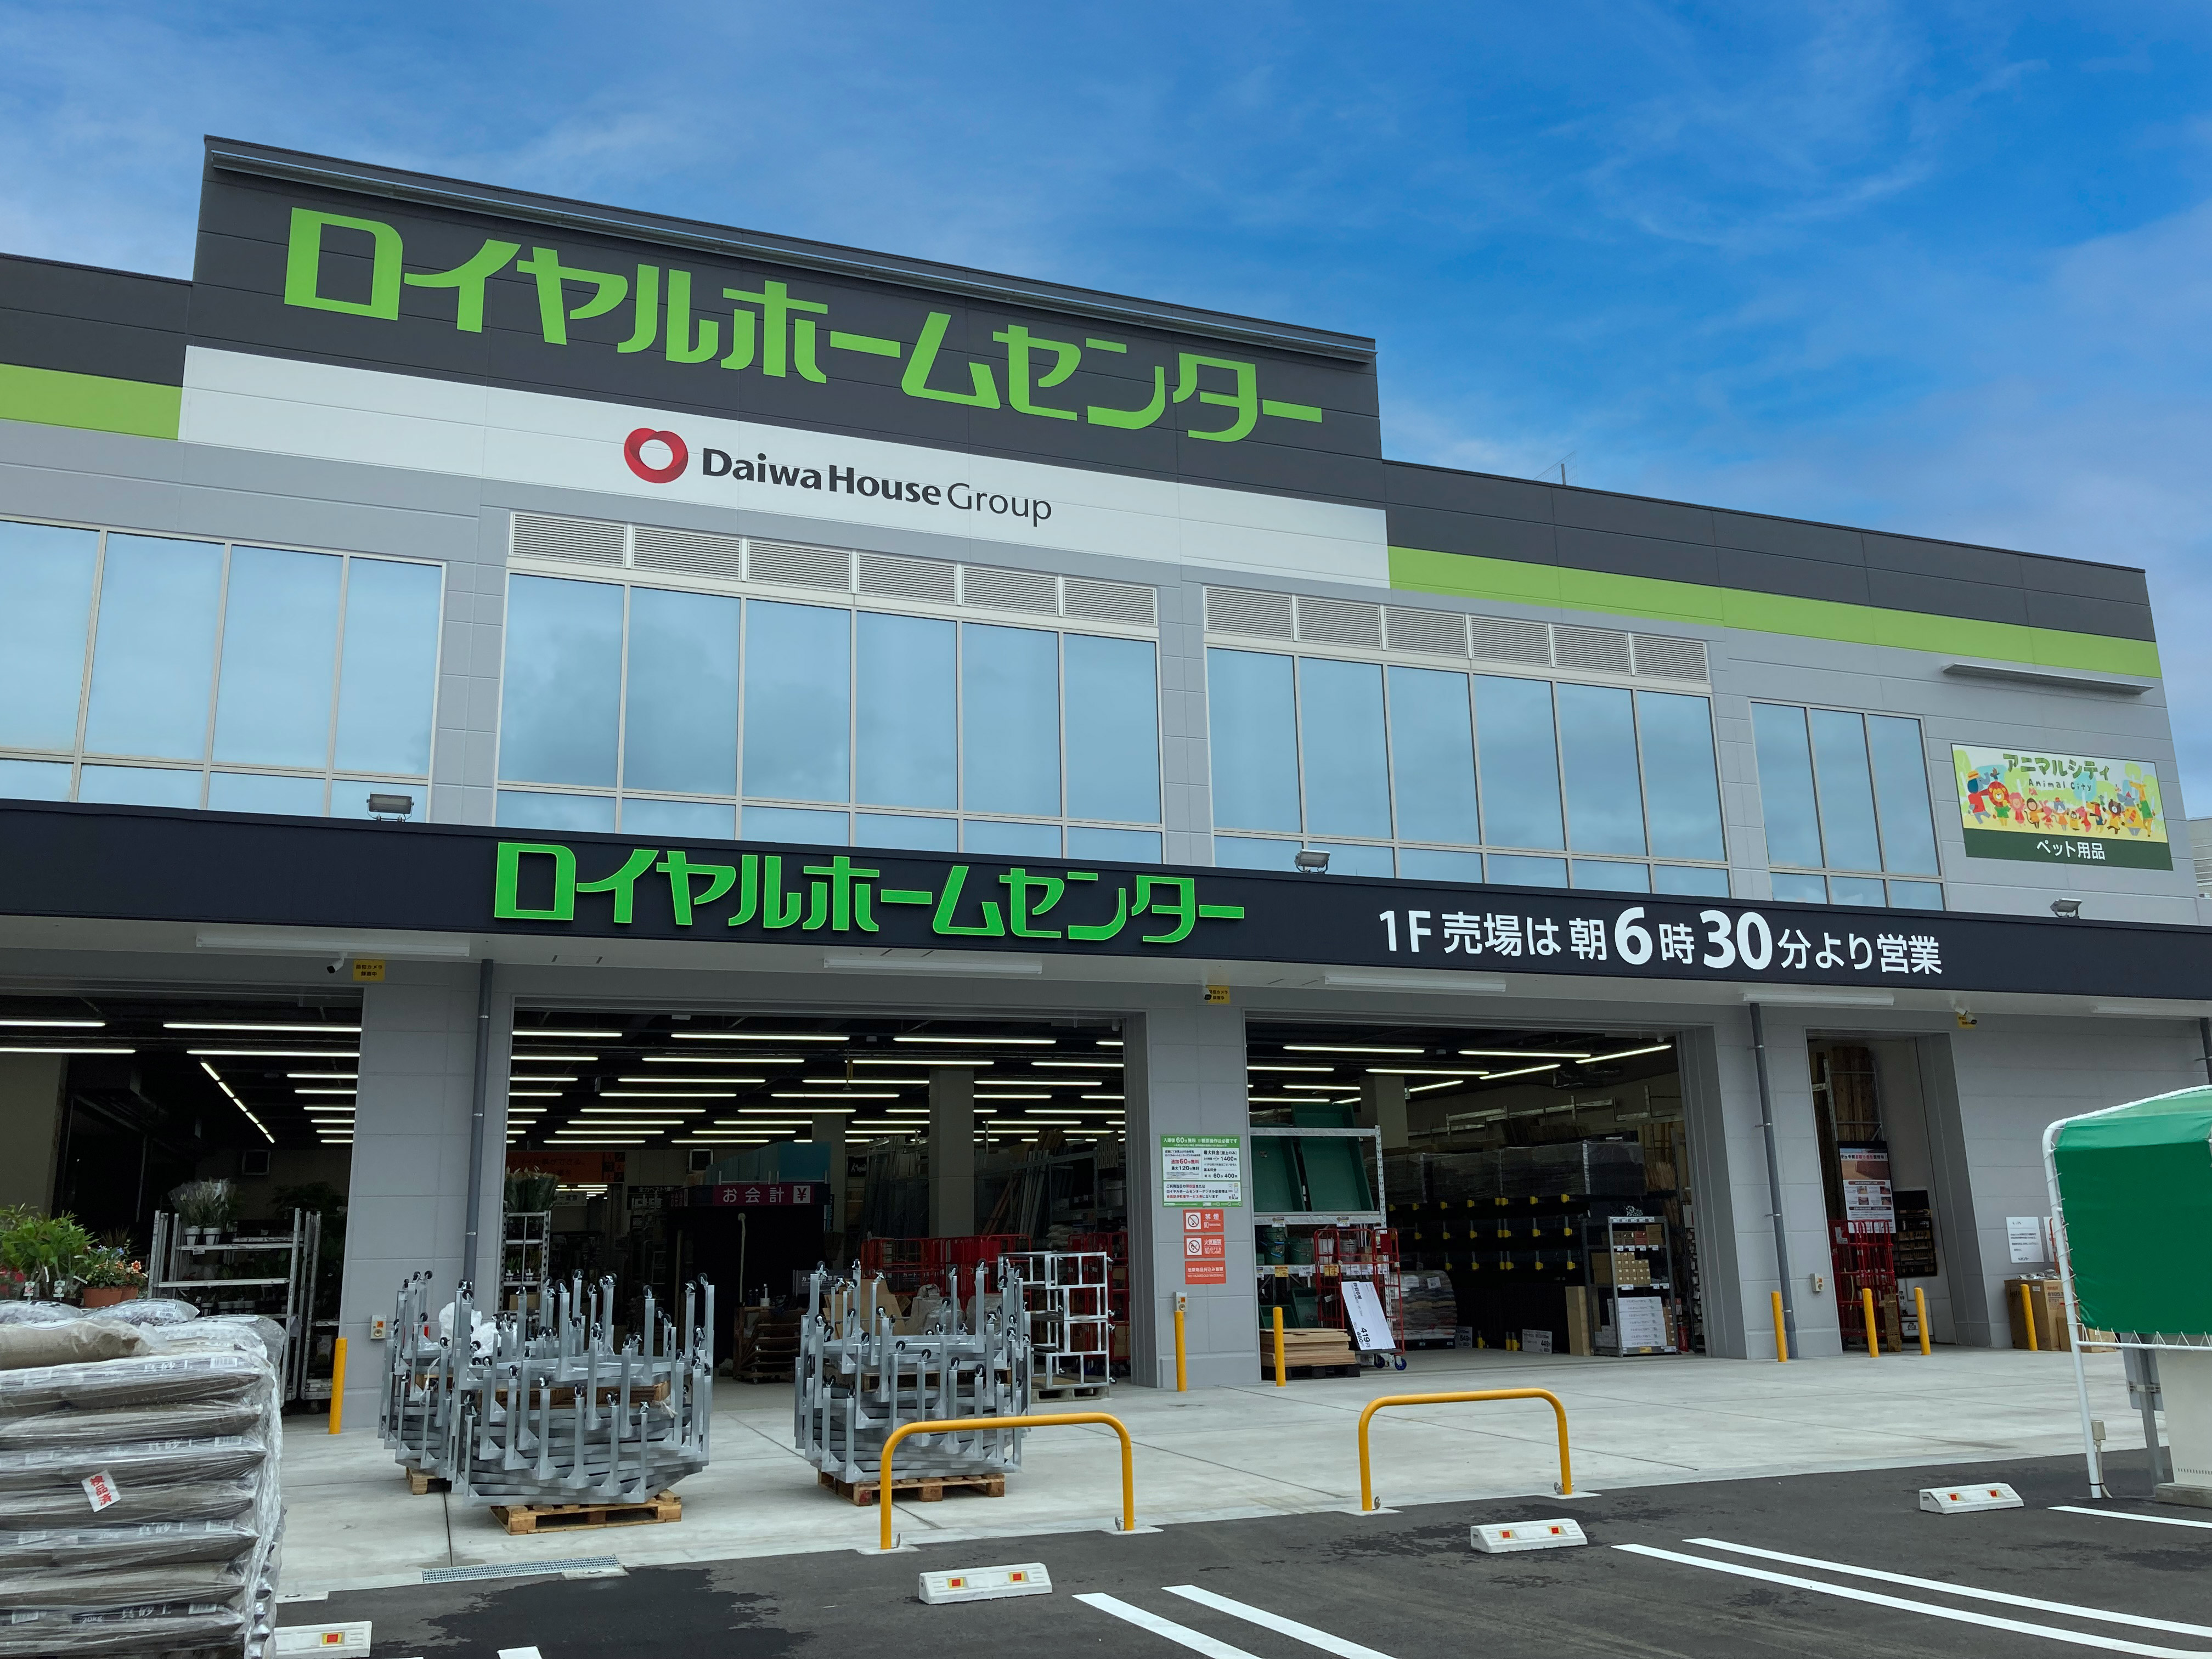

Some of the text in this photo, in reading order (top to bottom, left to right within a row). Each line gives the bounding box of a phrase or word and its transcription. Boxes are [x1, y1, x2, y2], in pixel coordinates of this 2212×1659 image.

[285, 210, 1321, 441] ロイヤルホームセンター
[702, 447, 1052, 527] Daiwa House Group
[2002, 753, 2109, 781] アニマルシティ
[2028, 778, 2092, 791] Animal City
[2036, 839, 2106, 860] ペット用品
[495, 843, 1243, 941] ロイヤルホームセンター
[723, 1187, 785, 1203] お会計
[81, 1615, 105, 1623] 20kg
